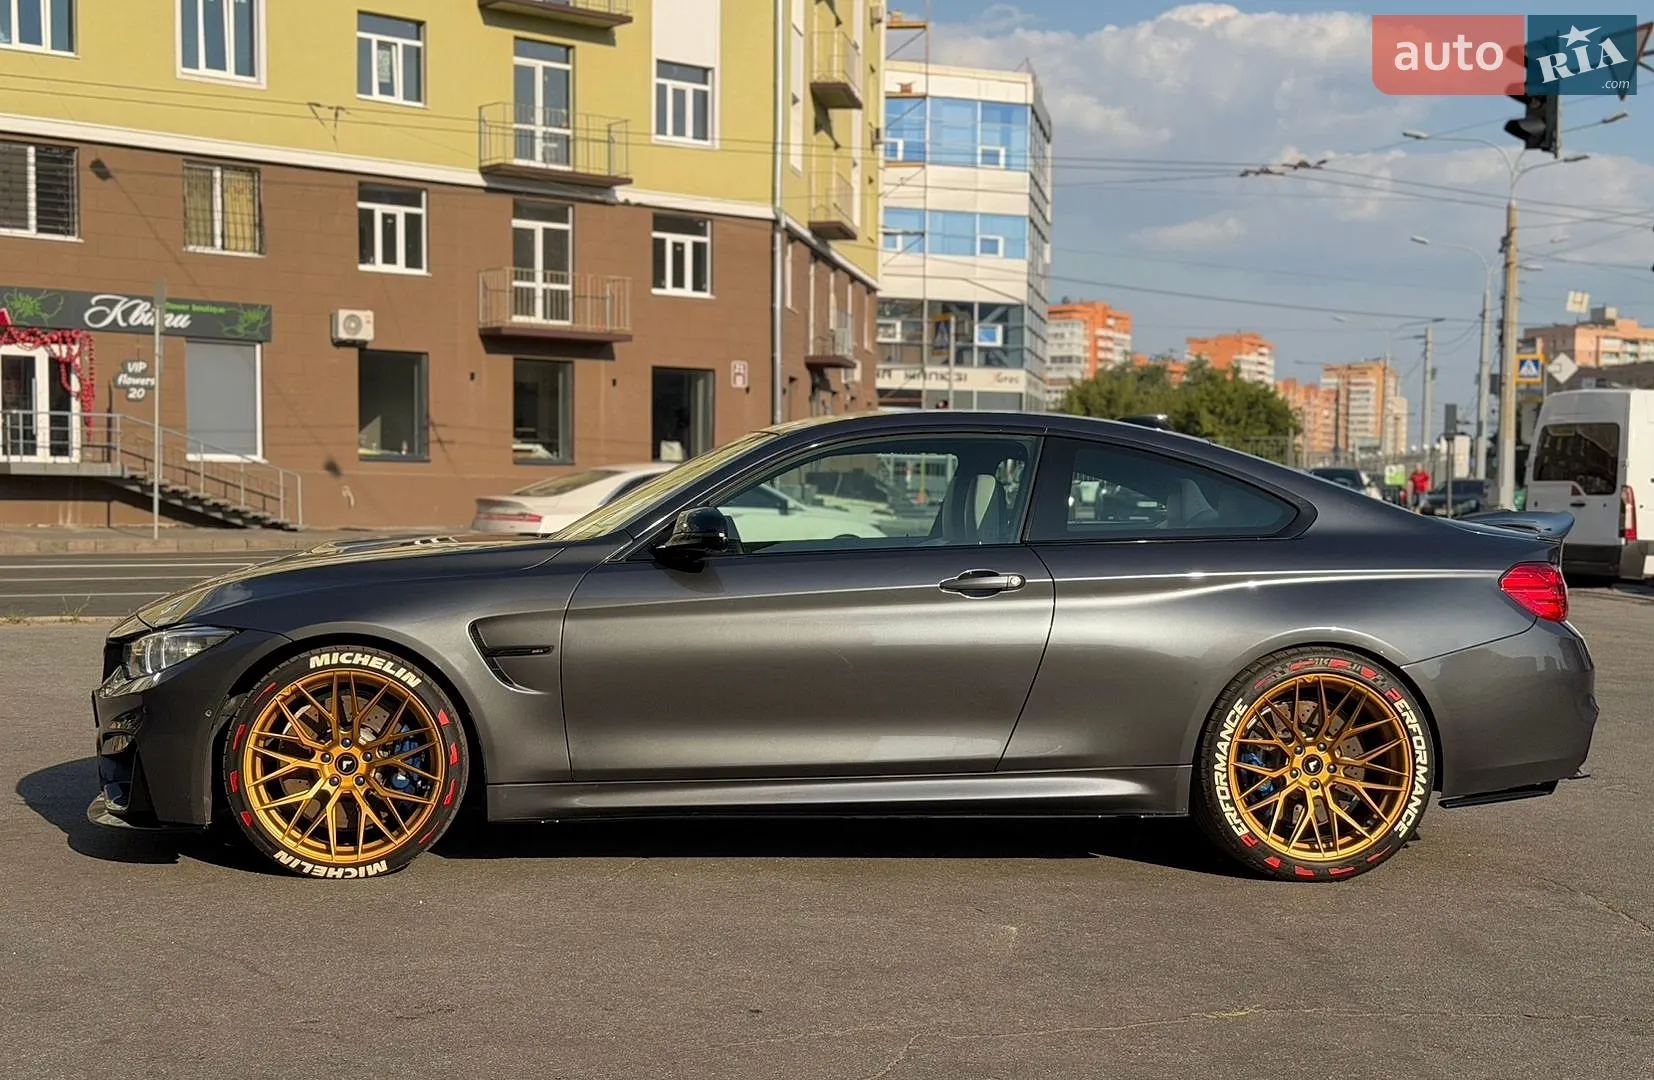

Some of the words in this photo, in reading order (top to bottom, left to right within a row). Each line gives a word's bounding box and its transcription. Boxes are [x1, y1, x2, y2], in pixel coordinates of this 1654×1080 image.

[127, 361, 147, 373] VIP
[117, 373, 156, 386] flowers
[127, 387, 146, 399] 20
[309, 652, 422, 688] MICHELIN
[273, 849, 389, 879] MICHELIN
